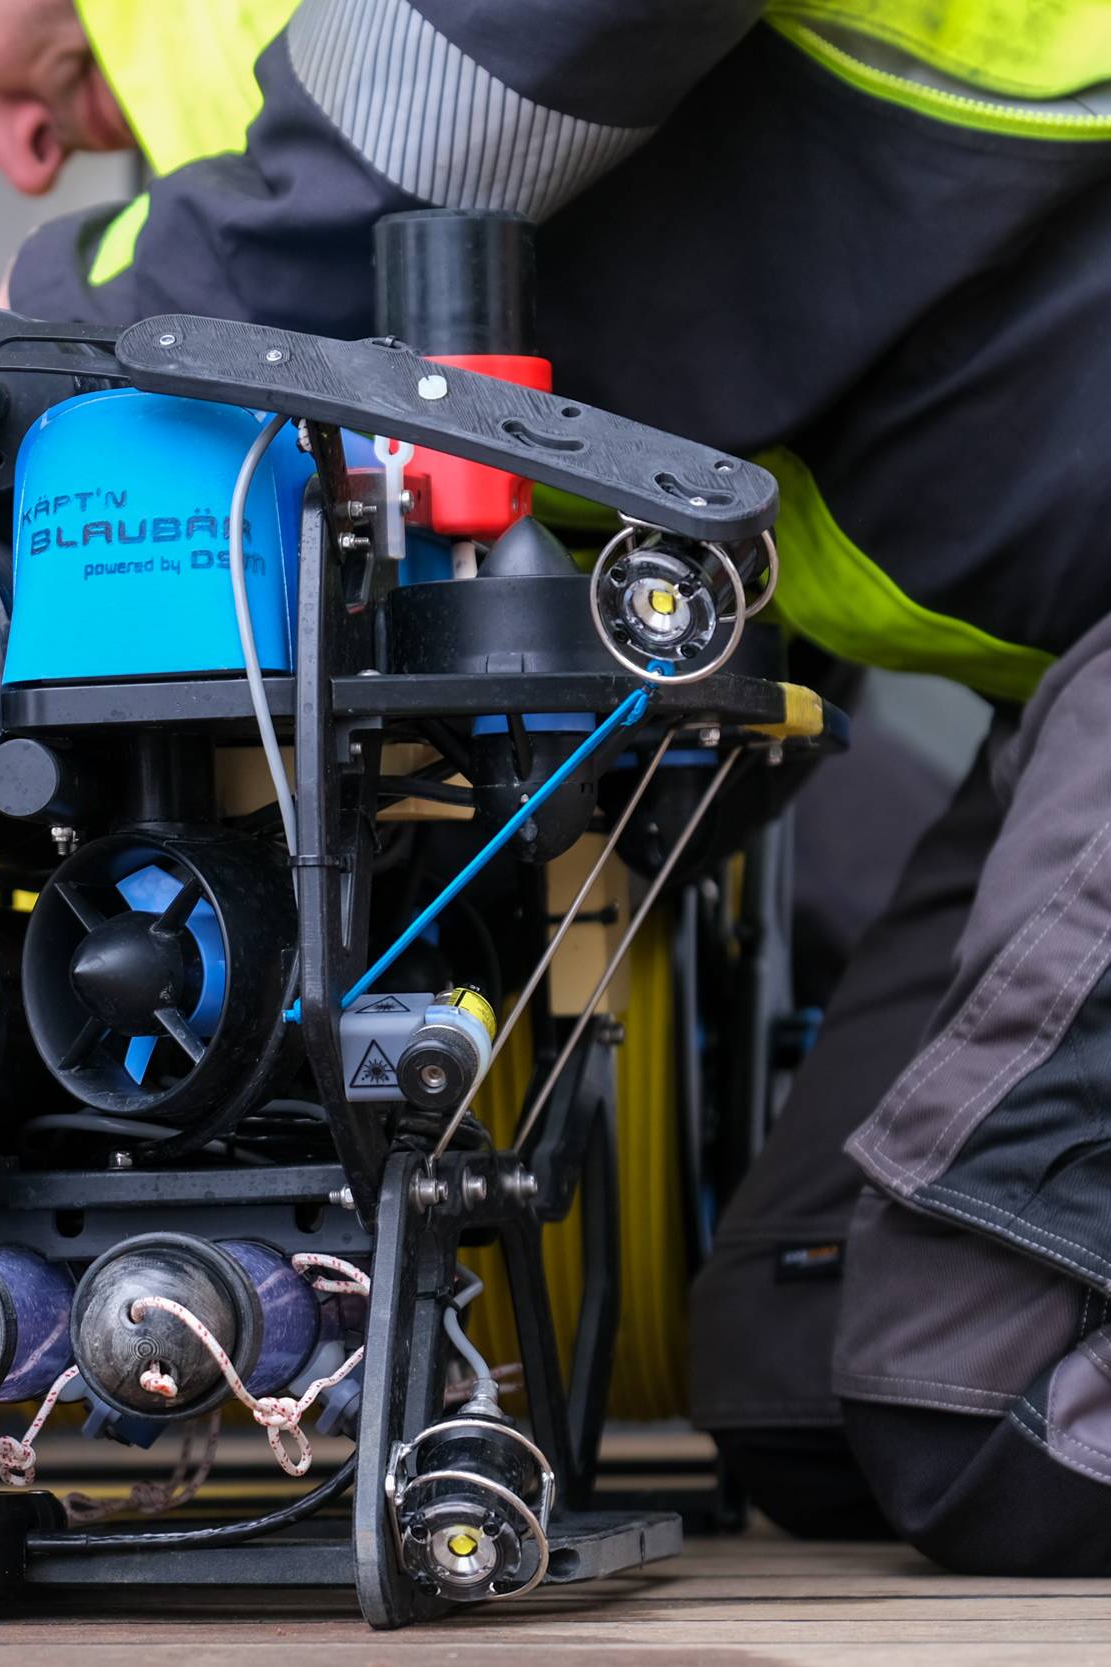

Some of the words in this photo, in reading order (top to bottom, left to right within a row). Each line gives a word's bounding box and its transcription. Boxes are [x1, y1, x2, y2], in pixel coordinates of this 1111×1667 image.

[30, 507, 252, 556] BLAUBÄR
[84, 557, 154, 580] powered
[160, 556, 181, 575] by
